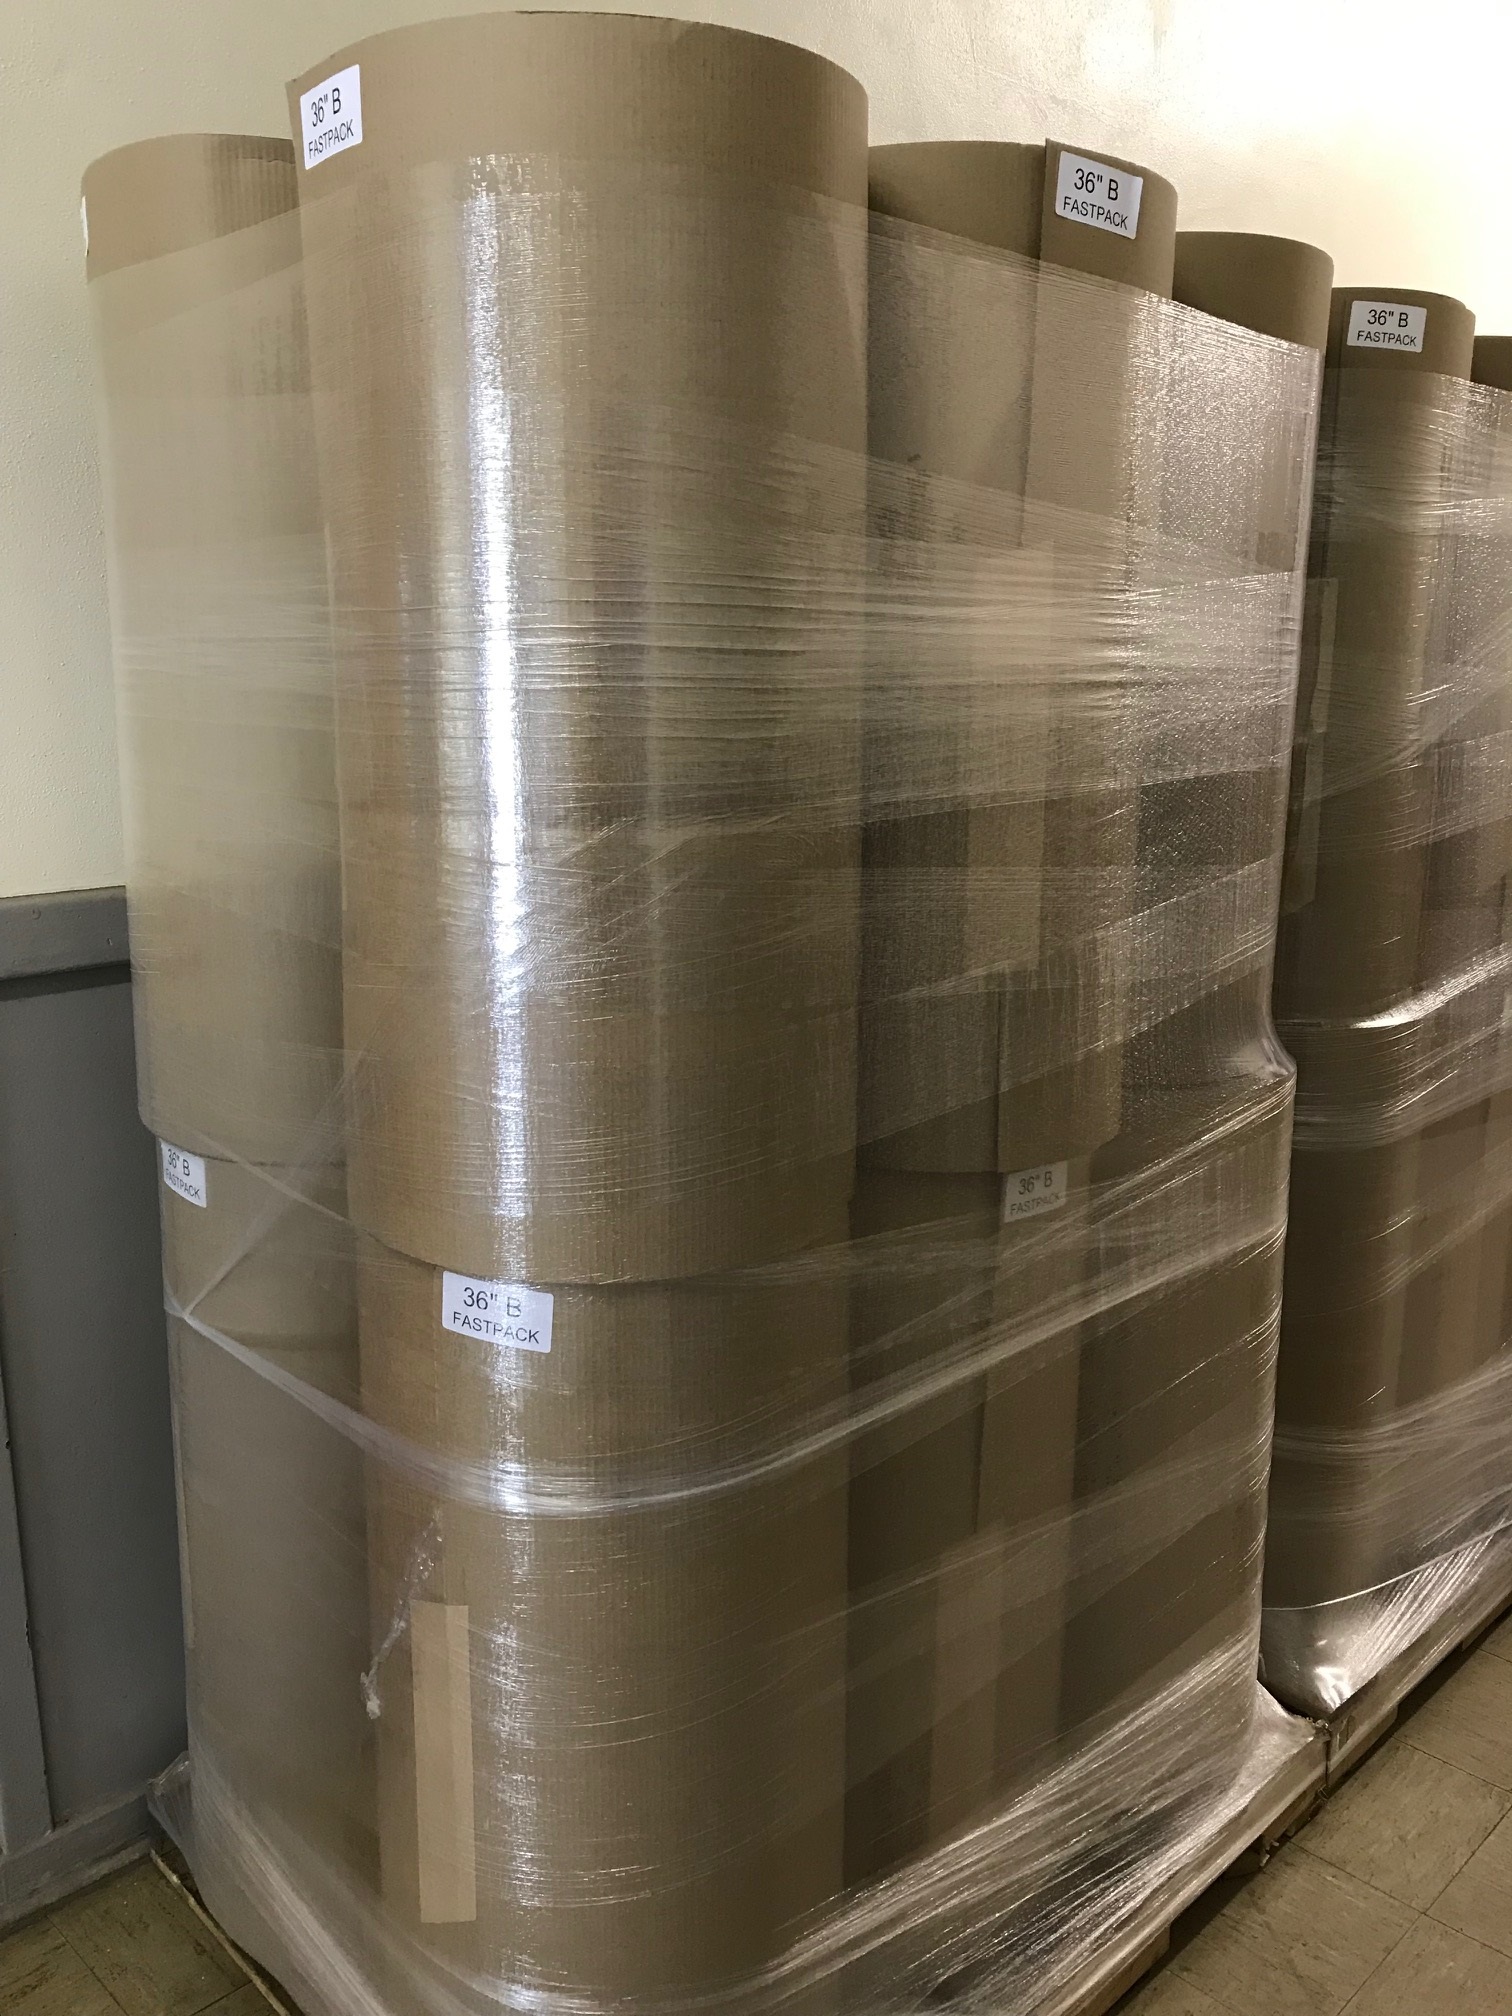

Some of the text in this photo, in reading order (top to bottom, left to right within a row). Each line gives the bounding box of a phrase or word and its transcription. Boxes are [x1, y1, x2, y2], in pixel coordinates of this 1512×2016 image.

[310, 87, 342, 127] 36" B
[308, 119, 354, 159] FASTPACK
[1073, 167, 1119, 201] 36" B
[1063, 195, 1128, 231] FASTPACK
[1367, 309, 1409, 328] 36" B
[1356, 330, 1417, 347] FASTPACK
[182, 1158, 191, 1177] B
[1018, 1170, 1053, 1195] 36" B
[463, 1286, 521, 1318] 36" B
[453, 1311, 540, 1344] FASTPACK
